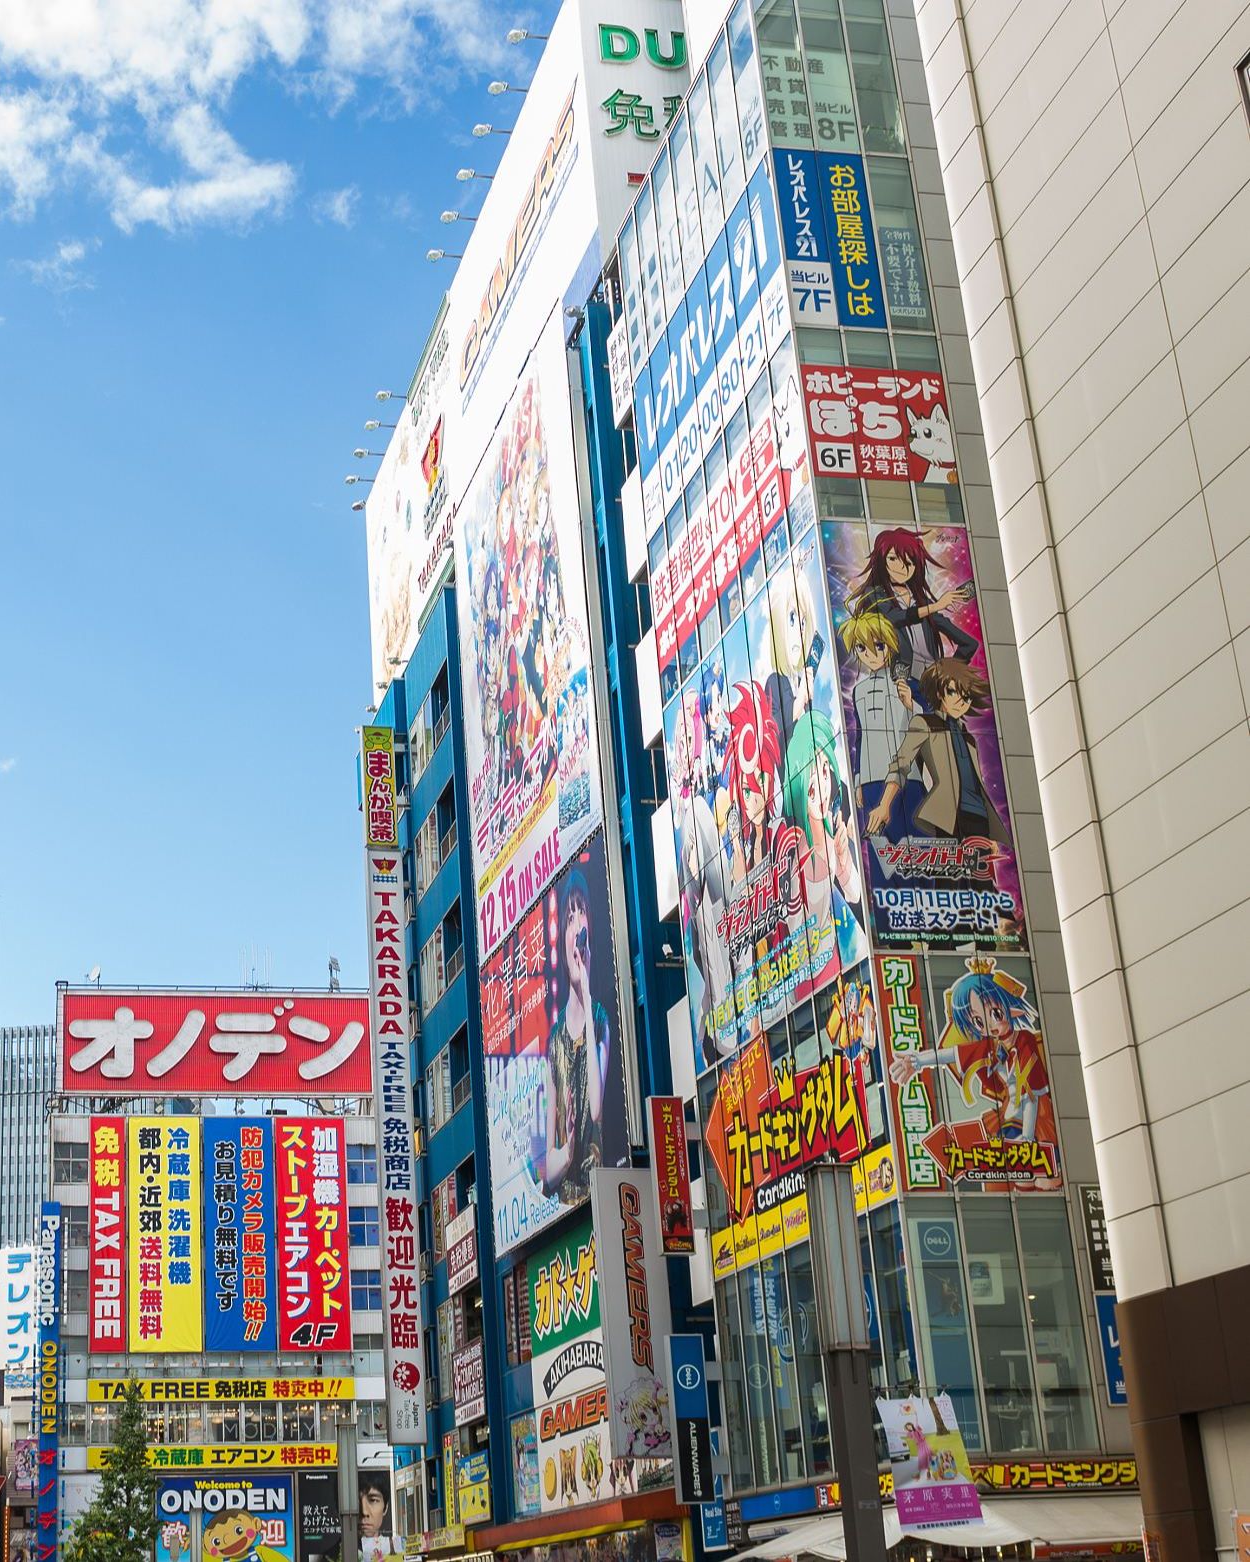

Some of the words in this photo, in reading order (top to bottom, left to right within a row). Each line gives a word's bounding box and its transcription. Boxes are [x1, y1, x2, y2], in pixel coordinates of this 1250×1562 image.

[763, 55, 825, 76] 不動産
[764, 76, 807, 96] 賃貸
[767, 98, 809, 117] 売買
[814, 102, 852, 116] 当ビル
[745, 112, 764, 162] 8F
[770, 120, 812, 140] 管理
[816, 117, 856, 143] 8F
[786, 153, 819, 258] レオパレス21
[460, 88, 577, 392] GAMERS
[828, 164, 875, 317] お部屋探しは
[884, 229, 912, 242] 全物件
[790, 270, 830, 285] 当ビル
[900, 242, 923, 307] 仲介手数料
[766, 296, 785, 334] 7F
[791, 286, 833, 314] 7F
[643, 192, 768, 448] レオパレス21
[805, 370, 941, 402] ホビーランド
[808, 394, 903, 441] ぽち
[819, 447, 852, 469] 6F
[859, 443, 908, 461] 秋葉原
[861, 460, 910, 477] 2号店
[763, 483, 779, 519] 6F
[417, 502, 458, 594] TAKARADA
[367, 749, 395, 843] まんが喫茶
[489, 832, 508, 860] School
[517, 782, 542, 821] Movie
[879, 845, 976, 866] ヴァンガード
[479, 864, 518, 955] 12.15
[518, 869, 534, 908] ON
[535, 826, 563, 890] SALE
[874, 889, 1016, 910] 10月11日(日)から
[889, 910, 1000, 930] 放送スタート!
[374, 890, 406, 1036] TAKARADA
[483, 918, 548, 1026] 花澤香菜
[68, 1000, 365, 1082] オノデン
[883, 958, 937, 1190] カードゲム専門店
[727, 1051, 867, 1213] カードキングダム
[94, 1126, 120, 1187] 免税
[166, 1127, 191, 1203] 冷蔵庫
[382, 1117, 412, 1191] 免税商店
[662, 1113, 680, 1198] カードキングダム
[944, 1142, 1054, 1170] カードキングダム
[95, 1191, 121, 1250] TAX
[213, 1141, 239, 1312] お見積り無料です
[496, 1191, 529, 1248] 11.04
[529, 1190, 561, 1224] Release
[167, 1208, 192, 1285] 洗濯機
[926, 1236, 949, 1246] DELL
[41, 1215, 60, 1327] Panasonic
[385, 1196, 420, 1350] 歓迎光臨
[618, 1181, 655, 1378] GAMERS
[6, 1253, 32, 1363] テレオン
[95, 1258, 121, 1340] FREE
[290, 1322, 338, 1348] 4F
[548, 1342, 604, 1390] AKIHABARA
[684, 1364, 693, 1390] DELL
[41, 1339, 58, 1434] ONODEN
[150, 1381, 210, 1399] FREE
[214, 1380, 267, 1399] 免税店
[396, 1408, 404, 1430] Shop
[540, 1388, 609, 1440] GAMER
[963, 1431, 979, 1441] Site
[152, 1449, 205, 1466] 冷蔵庫
[210, 1449, 276, 1466] エアコン
[688, 1420, 702, 1493] ALIENWARE
[1010, 1461, 1138, 1487] カードキングダ
[160, 1488, 286, 1514] ONODEN
[194, 1480, 240, 1491] Welcome
[240, 1480, 253, 1490] to
[903, 1487, 972, 1505] 茅原実里
[302, 1504, 329, 1516] 教えて
[302, 1516, 340, 1527] あげたい
[704, 1508, 715, 1519] Real
[714, 1506, 723, 1517] Site
[259, 1519, 286, 1547] 迎
